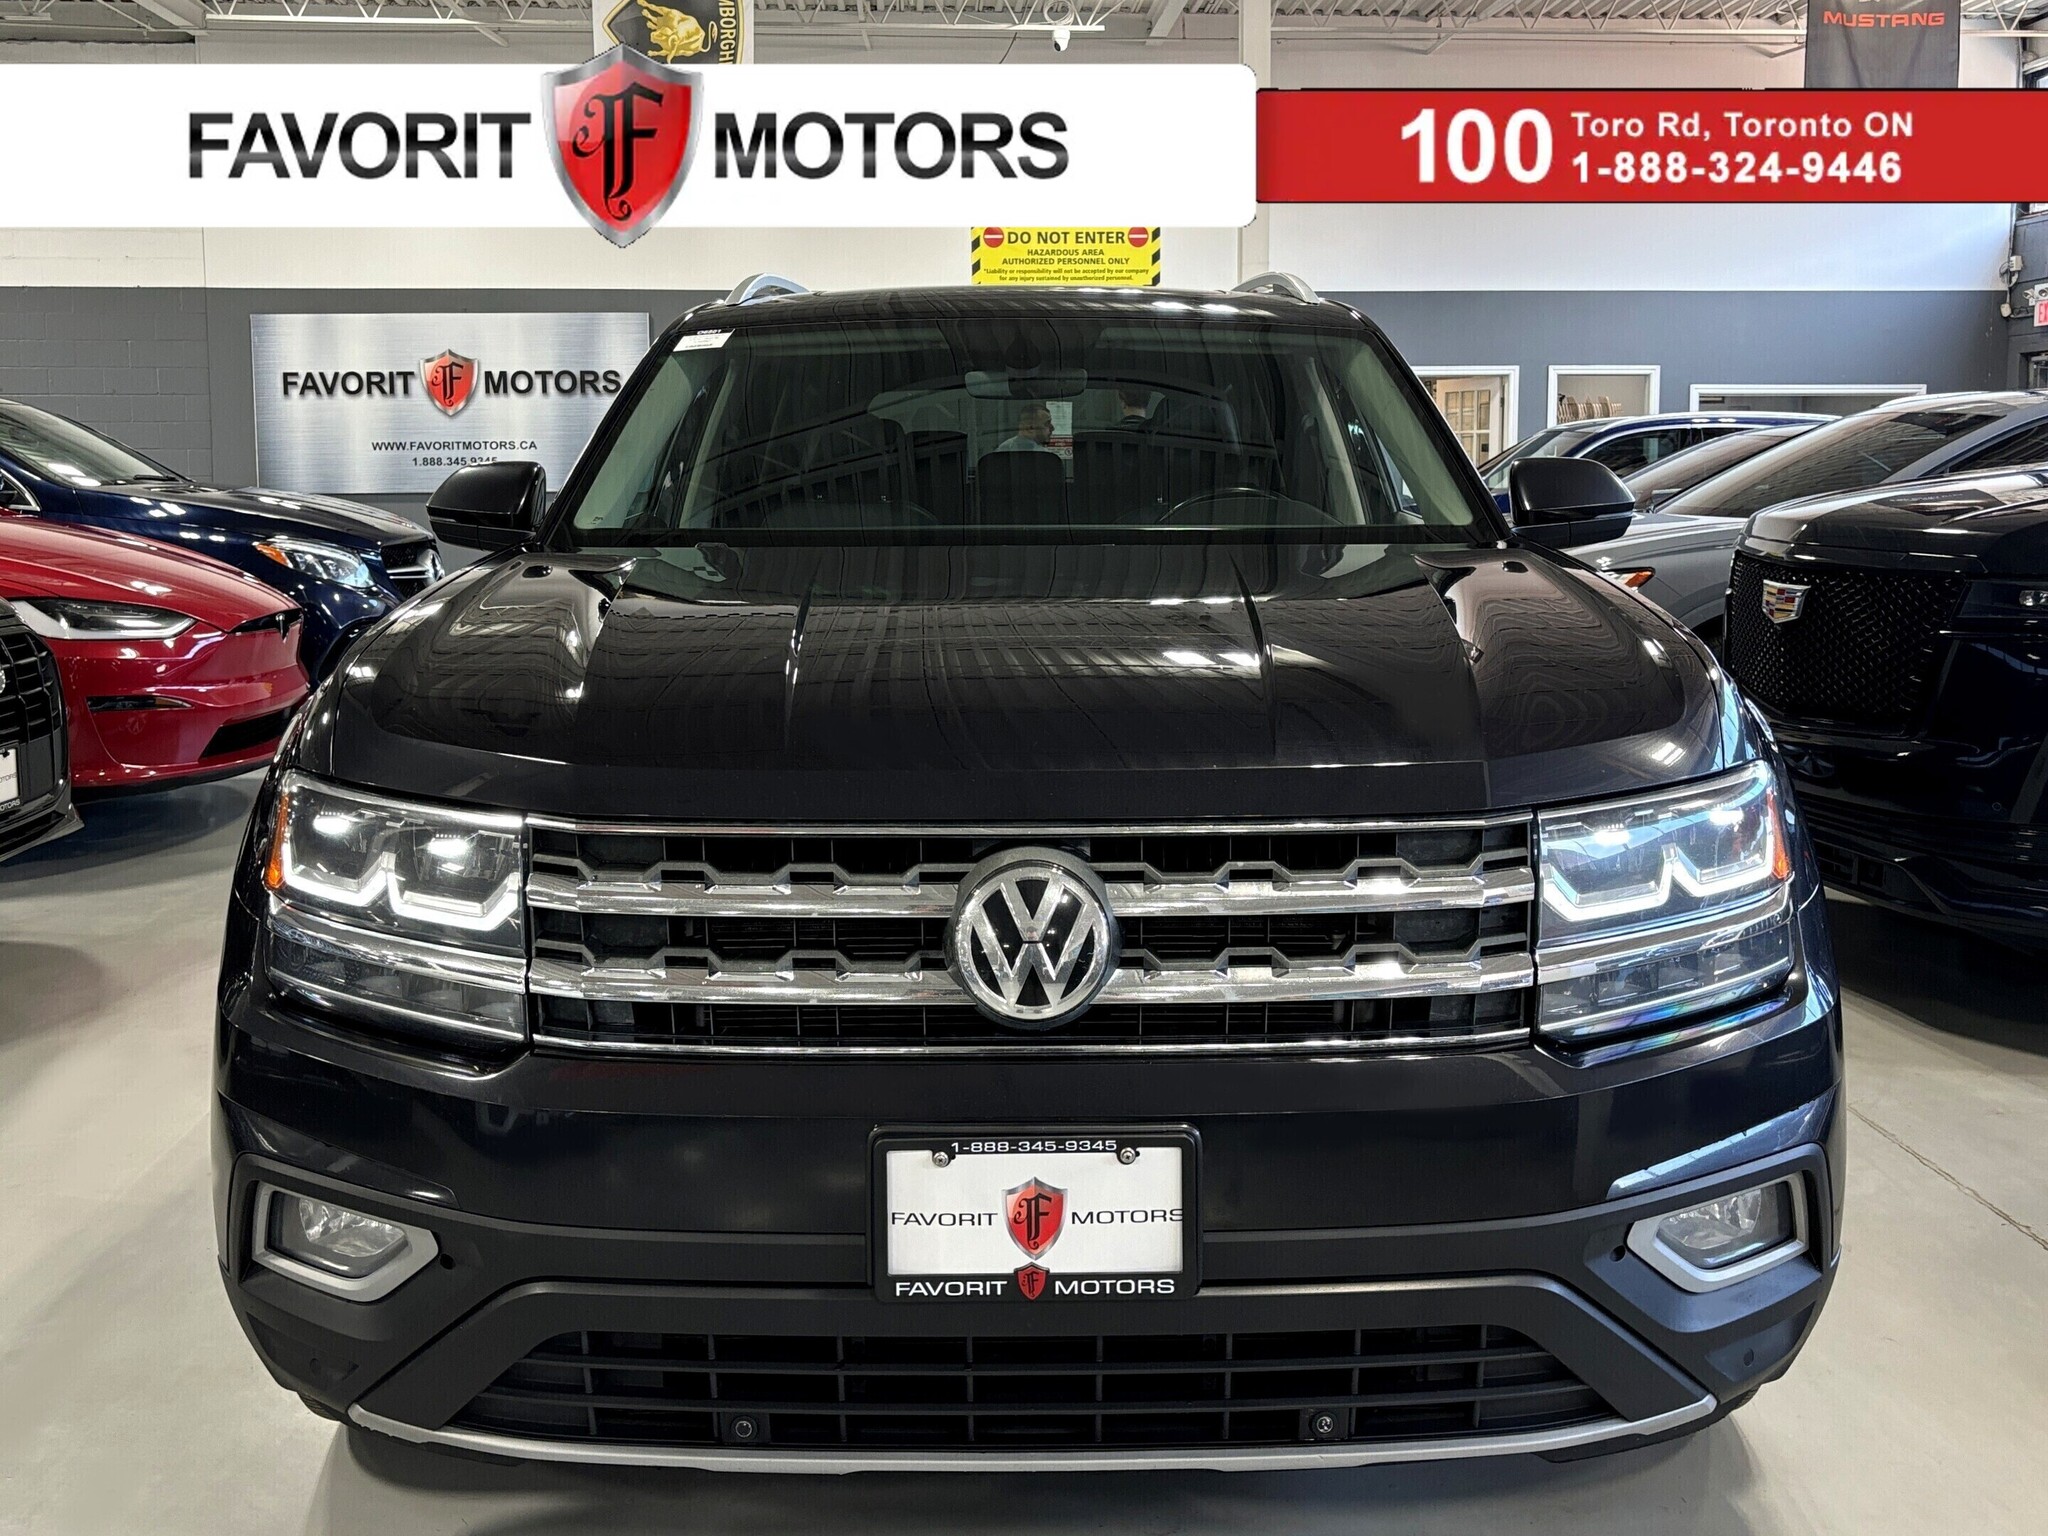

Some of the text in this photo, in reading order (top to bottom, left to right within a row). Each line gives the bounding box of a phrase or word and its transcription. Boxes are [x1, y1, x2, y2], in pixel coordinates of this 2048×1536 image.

[1823, 11, 1945, 28] MUSTANG
[1007, 231, 1126, 244] DO NOT ENTER
[1027, 248, 1105, 256] HAZARDOUS AREA
[1002, 257, 1130, 265] AUTHORIZED PERSONNEL ONLY
[282, 371, 415, 396] FAVORIT
[484, 370, 621, 395] MOTORS
[372, 440, 538, 451] WWW.FAVORITMOTORS.CA
[951, 1139, 1117, 1153] 1-888-345-9345
[891, 1212, 998, 1227] FAVORIT
[1071, 1208, 1184, 1225] MOTORS
[895, 1280, 1008, 1297] FAVORIT
[1054, 1279, 1175, 1295] MOTORS
